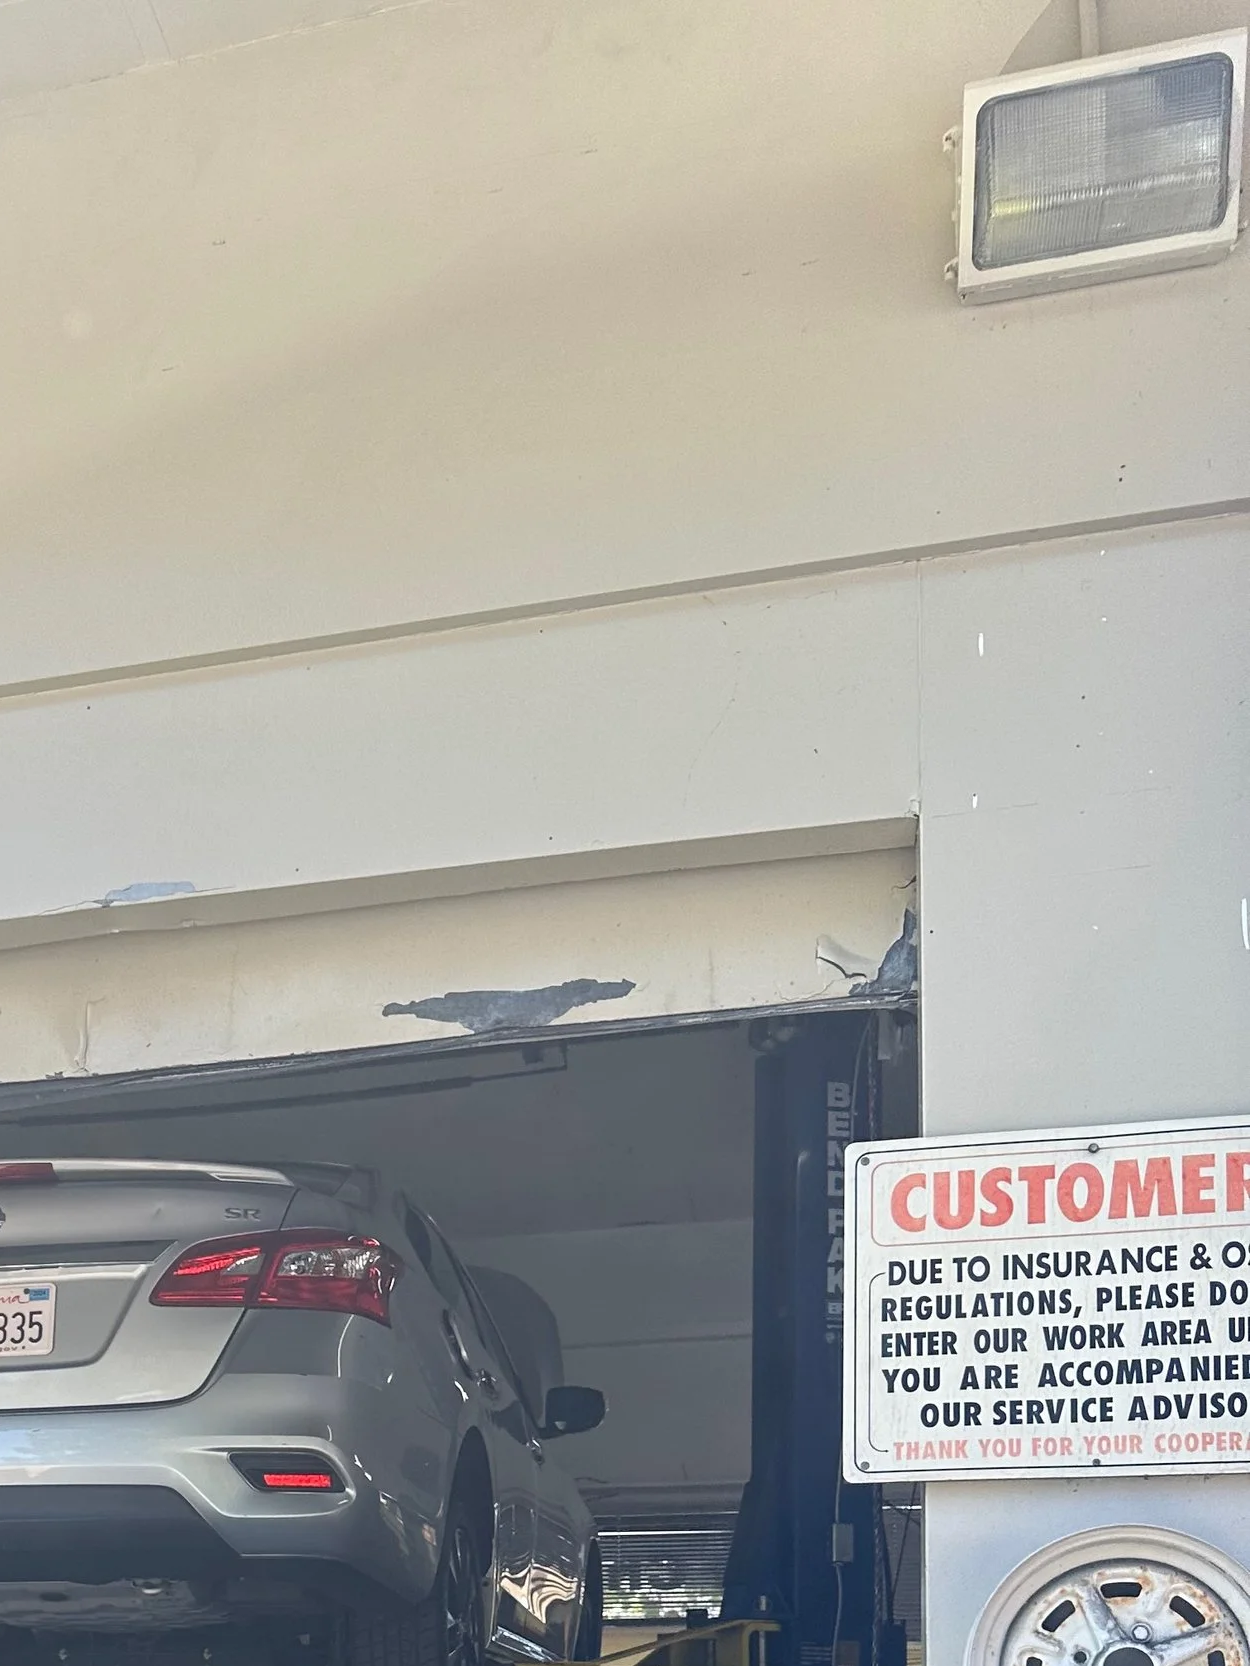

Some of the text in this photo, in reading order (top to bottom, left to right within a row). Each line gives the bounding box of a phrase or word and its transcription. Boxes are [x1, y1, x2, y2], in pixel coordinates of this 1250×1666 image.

[224, 1207, 262, 1220] SR
[888, 1241, 1250, 1286] DUE TO INSURANCE & O
[881, 1280, 1248, 1322] REGULATIONS, PLEASE DO
[881, 1317, 1250, 1358] ENTER OUR WORK AREA U
[882, 1367, 940, 1394] YOU
[960, 1363, 1019, 1390] ARE
[920, 1392, 1248, 1428] OUR SERVICE ADVISO
[893, 1438, 969, 1461] THANK
[979, 1436, 1022, 1458] YOU
[1031, 1435, 1073, 1457] FOR
[1083, 1434, 1143, 1456] YOUR
